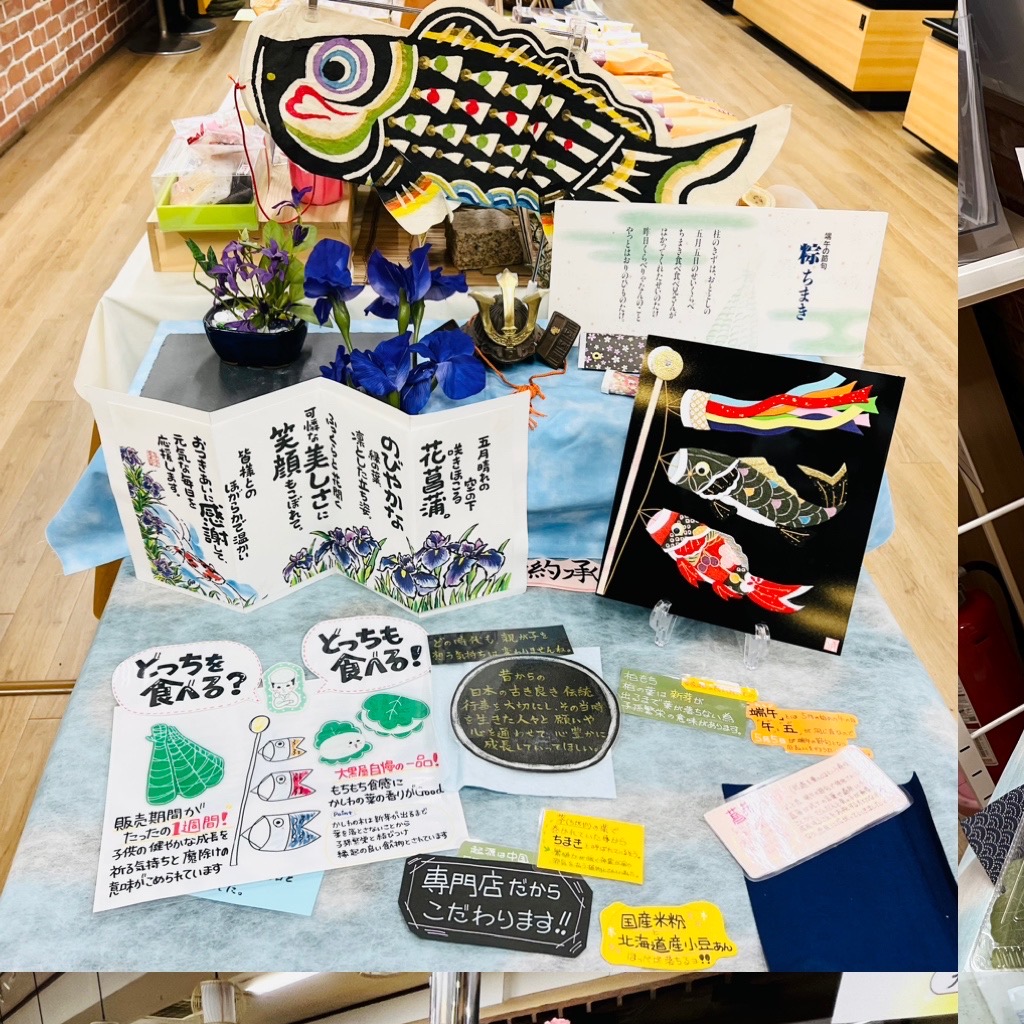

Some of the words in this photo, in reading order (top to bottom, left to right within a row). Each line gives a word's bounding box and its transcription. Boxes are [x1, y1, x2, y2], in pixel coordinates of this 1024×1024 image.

[821, 232, 832, 270] 端午の節句
[238, 448, 257, 499] 皆様との
[303, 407, 332, 520] 可憐な美しさに
[448, 443, 463, 504] 咲きほこる
[477, 436, 491, 491] 五月晴れの
[381, 436, 404, 531] のびやかな
[464, 477, 477, 511] 空の下
[318, 626, 403, 654] どっちも
[135, 653, 225, 678] どっちを
[331, 646, 422, 683] 食べる!
[499, 669, 545, 682] 昔からの
[624, 671, 657, 685] 柏もち
[140, 672, 247, 707] 食べる?
[469, 685, 594, 698] 日本の古き良き伝統
[622, 682, 703, 705] 柏の葉は新芽が
[464, 715, 594, 725] を生きた人々と願いや
[334, 753, 439, 779] 大黒屋自慢の一品!
[331, 778, 403, 795] もちもち食感に
[114, 803, 205, 831] 販売期間が
[124, 812, 228, 844] たったの1週間!
[112, 830, 228, 860] 子供の健やかな成長を
[110, 847, 229, 878] 祈る気持ちと魔除けの
[109, 863, 222, 897] 意味がこめられています
[422, 865, 560, 900] 専門店だから
[621, 911, 687, 930] 国産米粉
[618, 934, 732, 953] 北海道産小豆あん
